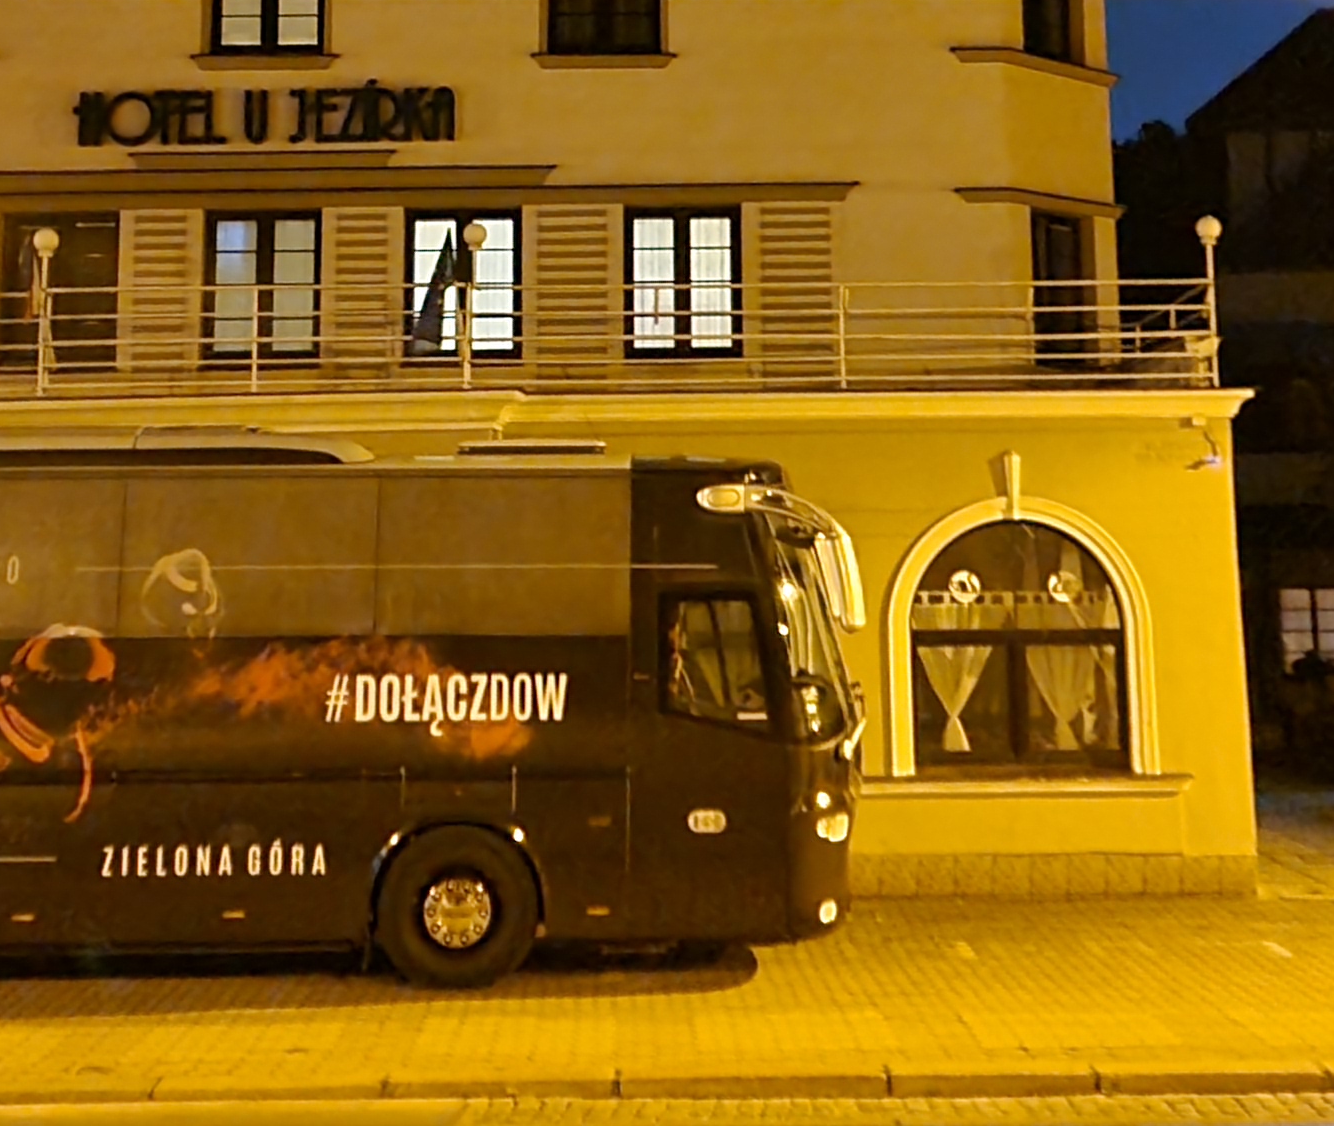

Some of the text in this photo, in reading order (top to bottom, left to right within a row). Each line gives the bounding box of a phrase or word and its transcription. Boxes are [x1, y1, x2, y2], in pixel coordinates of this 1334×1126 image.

[73, 78, 456, 146] HOTEL U JEZÍRKA
[325, 672, 568, 737] #DOŁĄCZDOW
[101, 837, 326, 878] ZIELONA GÓRA
